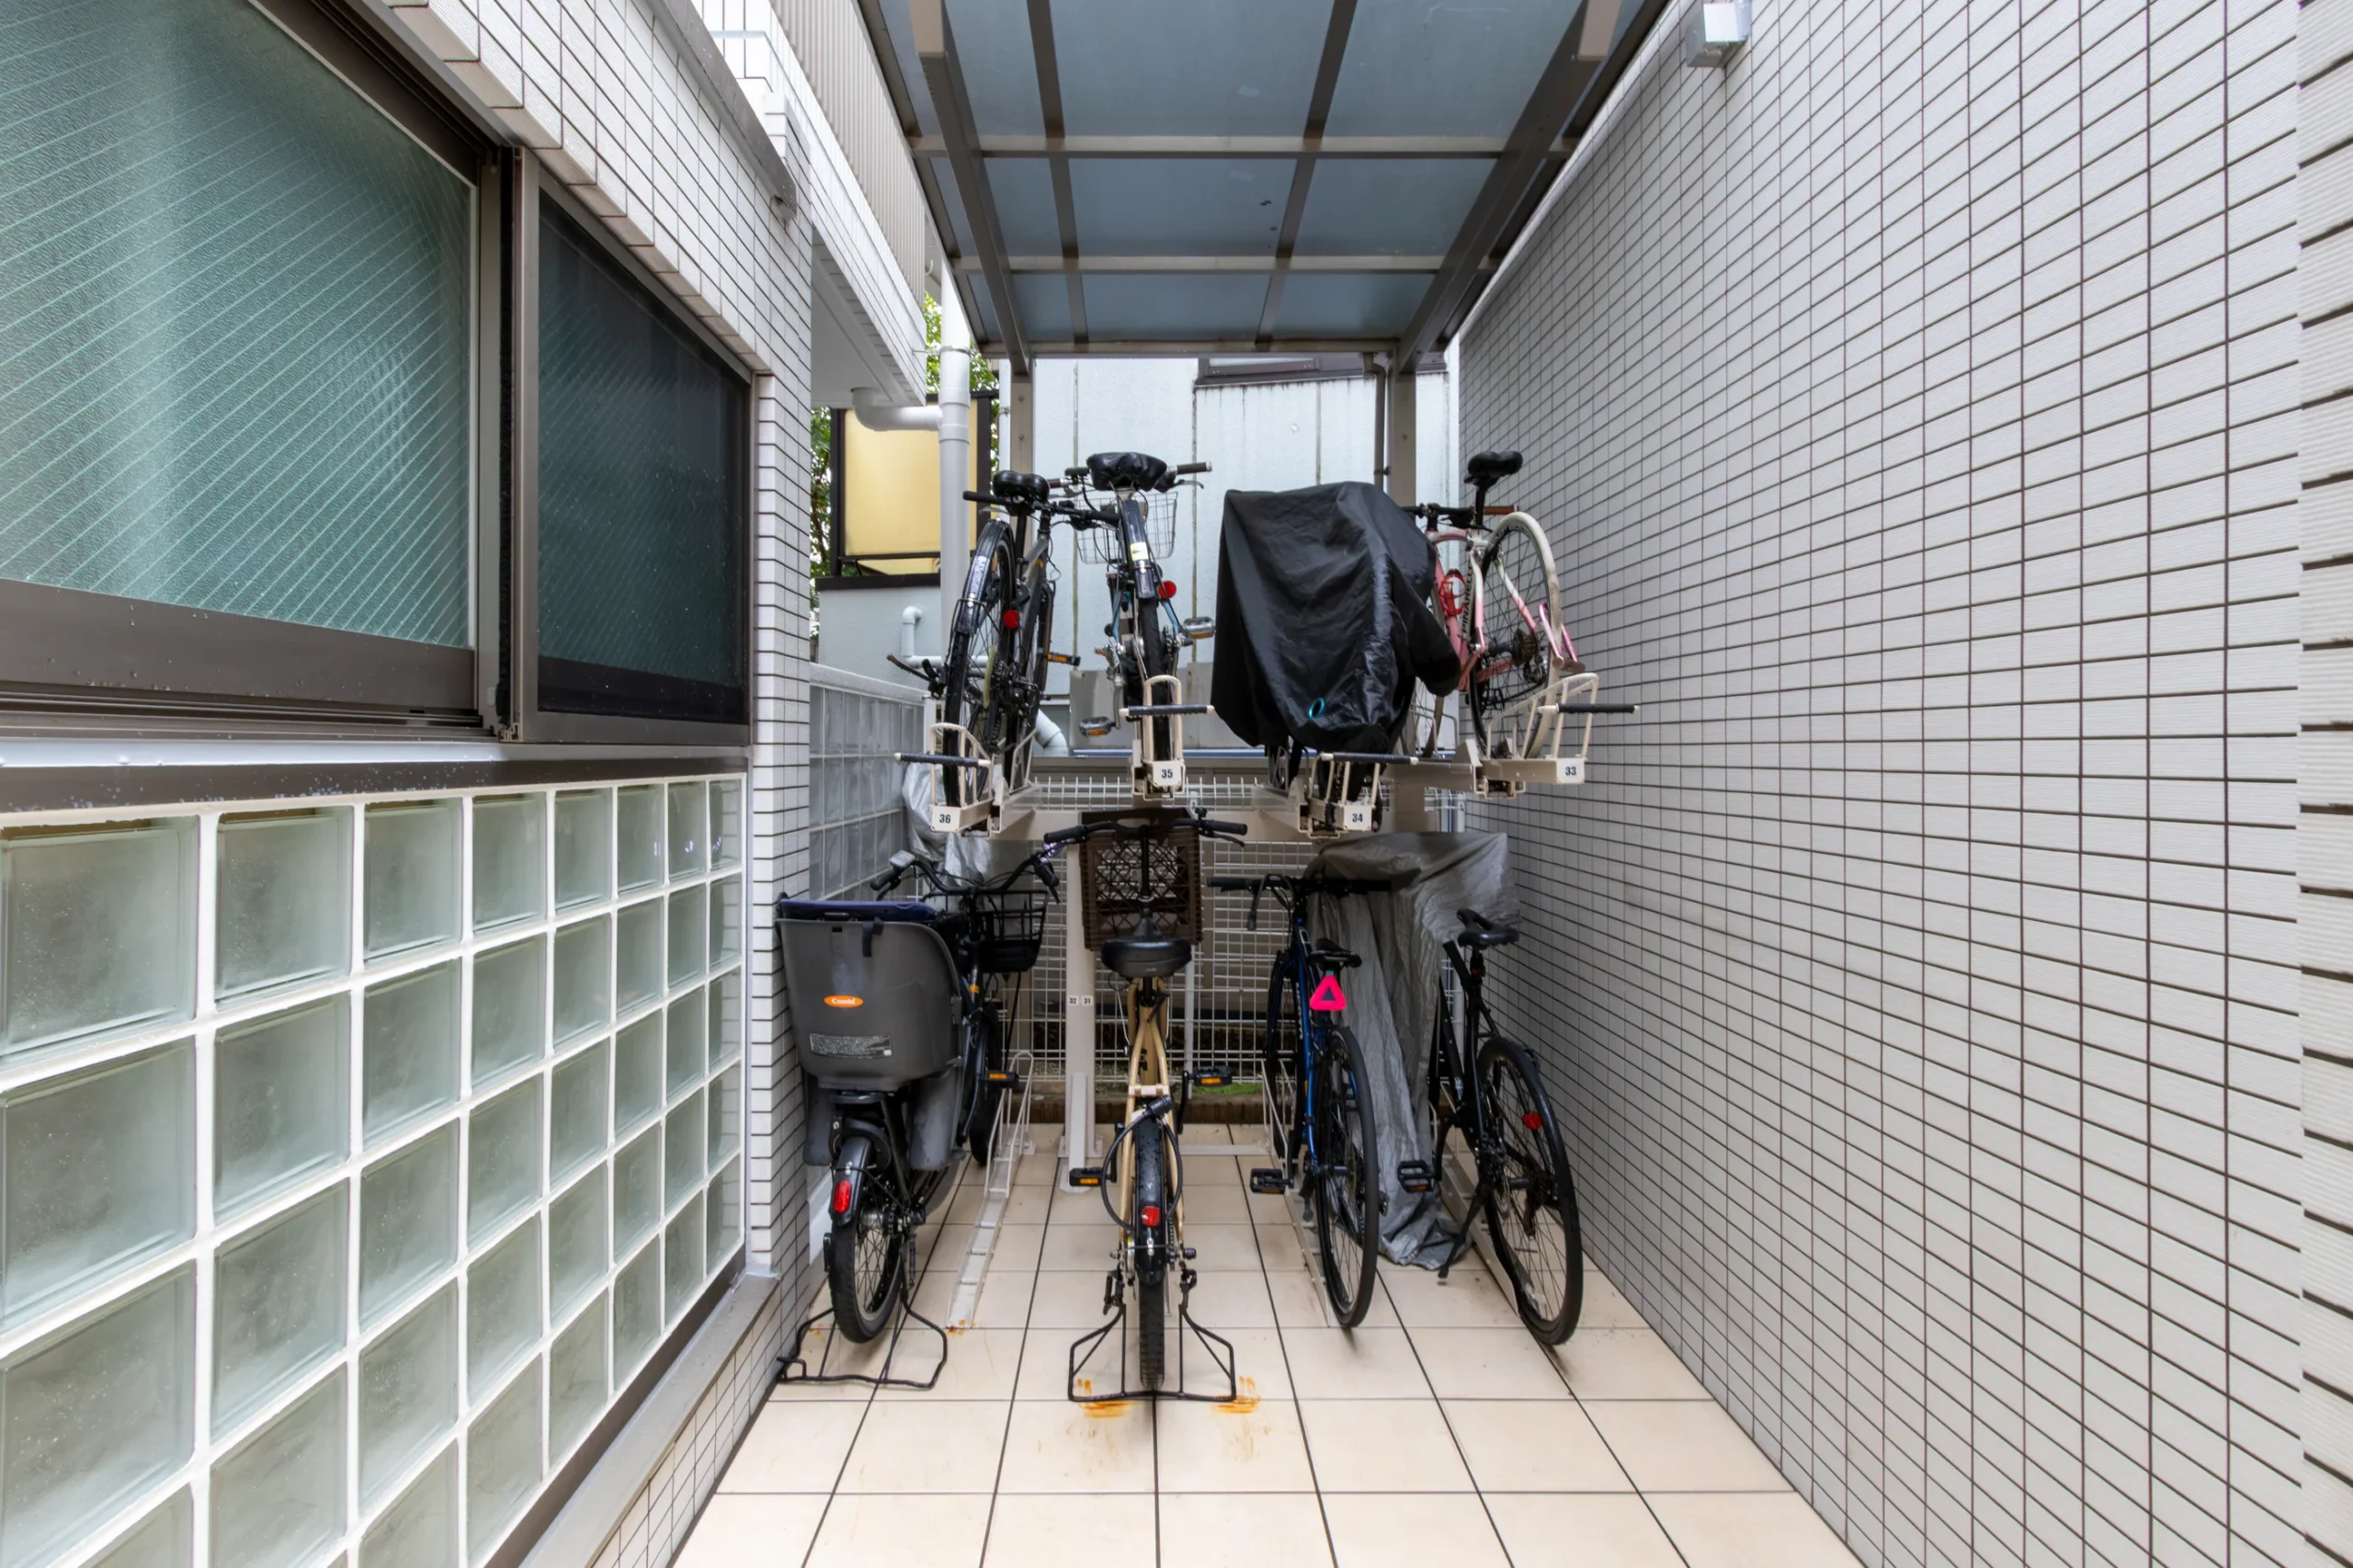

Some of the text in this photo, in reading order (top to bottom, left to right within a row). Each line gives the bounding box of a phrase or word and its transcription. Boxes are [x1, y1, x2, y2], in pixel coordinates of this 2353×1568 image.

[1161, 768, 1174, 779] 35
[1564, 766, 1577, 776] 33
[938, 812, 952, 824] 36
[1351, 812, 1364, 823] 34
[831, 996, 856, 1005] Combi
[1068, 996, 1077, 1005] 32
[1083, 996, 1091, 1005] 31
